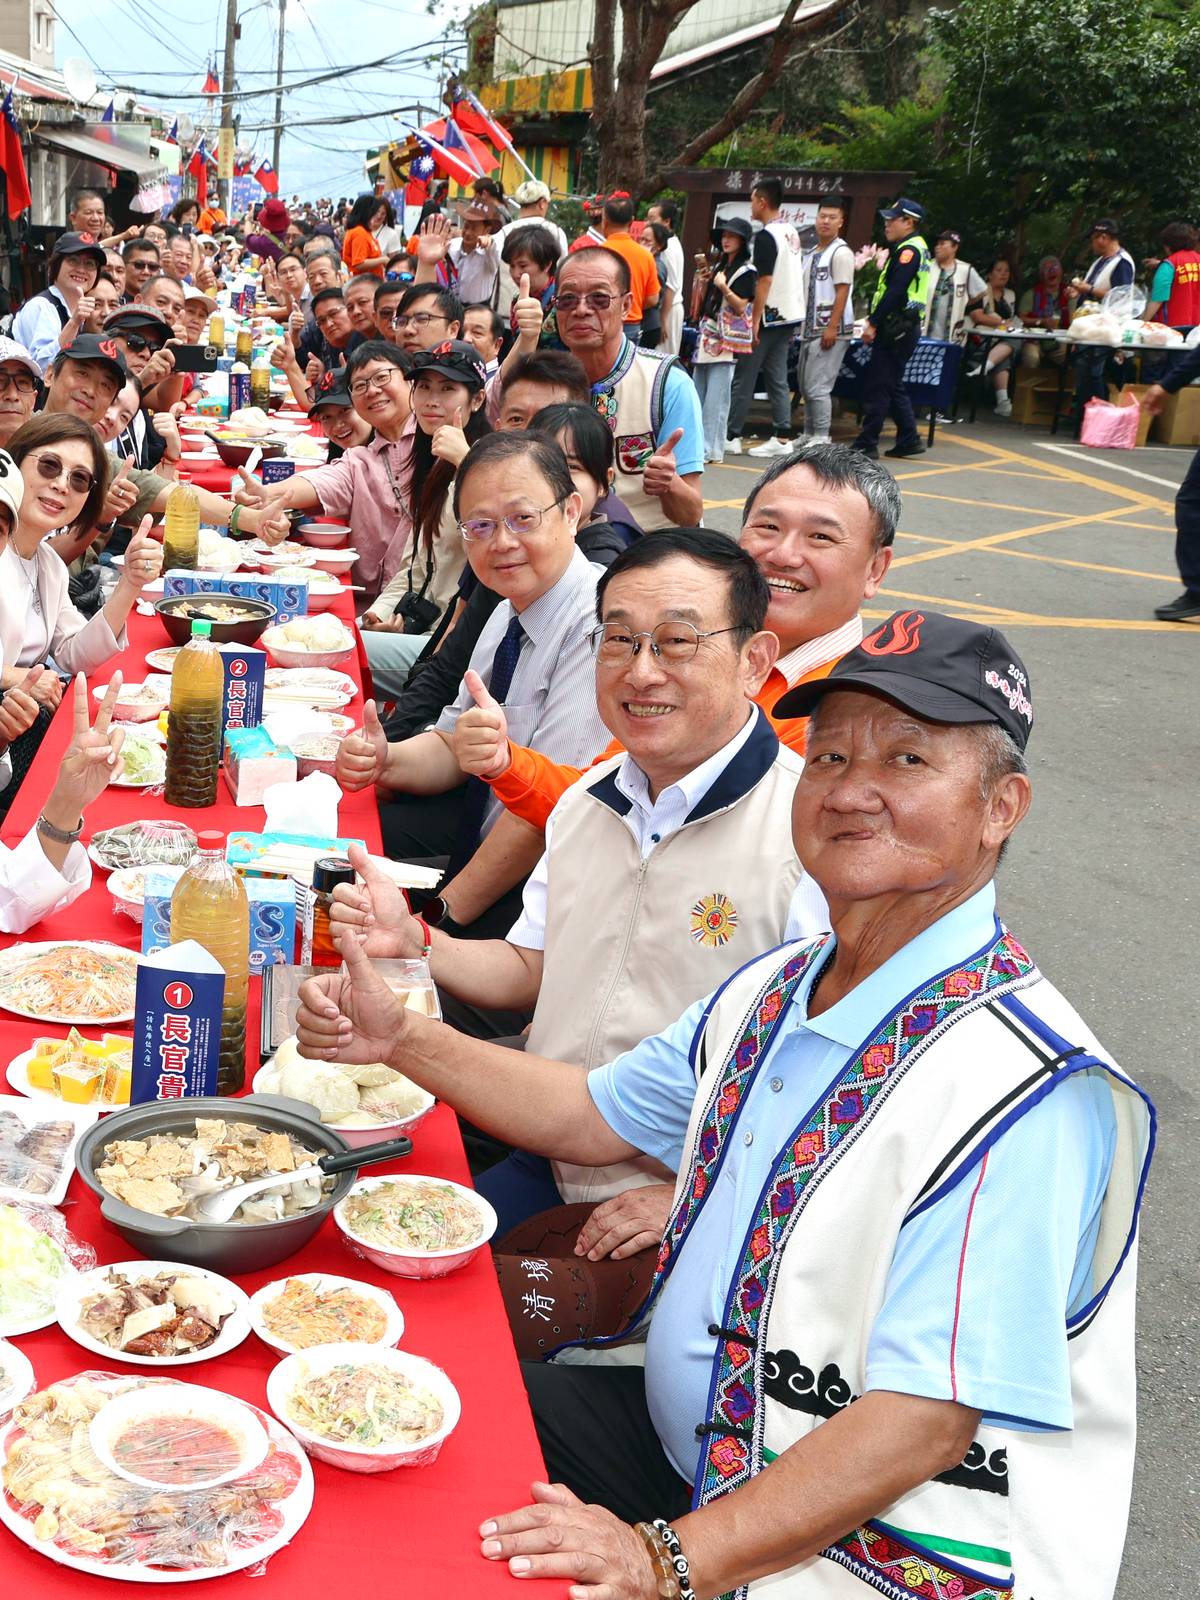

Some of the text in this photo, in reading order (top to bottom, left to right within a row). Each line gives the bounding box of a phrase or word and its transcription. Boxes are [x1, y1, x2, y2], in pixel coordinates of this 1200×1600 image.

[1008, 663, 1026, 687] 2024
[254, 904, 284, 943] S
[156, 1013, 192, 1100] 長官貴
[520, 1258, 556, 1322] 清境
